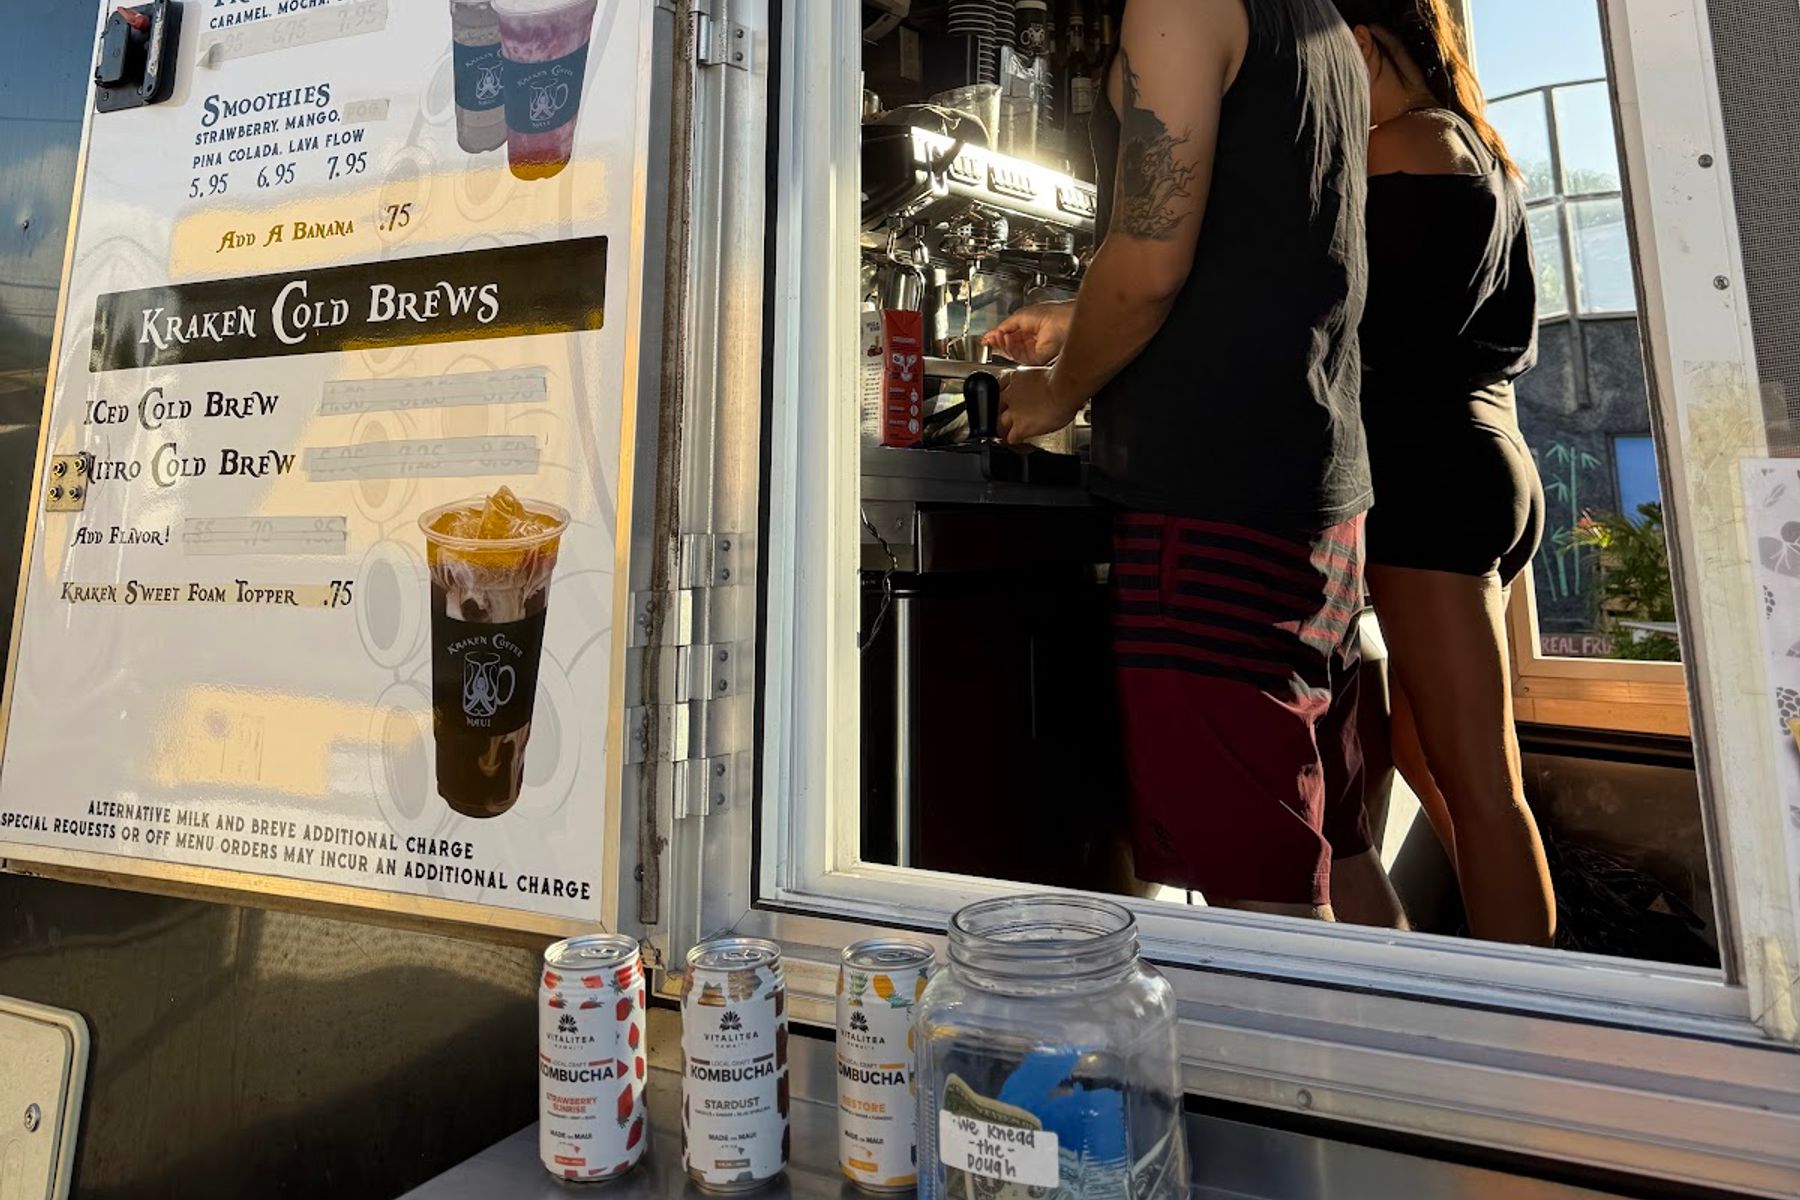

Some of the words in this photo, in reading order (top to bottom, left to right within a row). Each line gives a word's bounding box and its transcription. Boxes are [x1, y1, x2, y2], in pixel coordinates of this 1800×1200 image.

[201, 82, 331, 127] SMOOTHIES
[192, 152, 222, 169] PINA
[289, 136, 319, 153] LAVA
[325, 128, 365, 147] FLOW
[189, 173, 229, 198] 5.95
[256, 162, 296, 188] 6.95
[327, 151, 368, 180] 7.95
[216, 230, 255, 253] ADD
[263, 224, 284, 247] A
[292, 220, 354, 241] BANANA
[379, 202, 412, 233] .75
[139, 305, 257, 350] KRAKEN
[271, 280, 349, 344] COLD
[366, 281, 499, 323] BREWS
[83, 400, 129, 425] ICED
[138, 387, 192, 431] COLD
[204, 391, 279, 419] BREW
[151, 443, 207, 487] COLD
[218, 449, 296, 478] BREW
[71, 526, 103, 547] ADD
[108, 525, 170, 546] FLAVOR!
[61, 582, 117, 604] KRAKEN
[125, 580, 180, 605] SWEET
[188, 583, 226, 602] FOAM
[235, 578, 299, 606] TOPPER
[323, 580, 354, 608] .75
[88, 800, 170, 823] ALTERNATIVE
[177, 809, 209, 828] MILK
[216, 814, 245, 833] AND
[251, 819, 296, 838] BREVE
[302, 823, 398, 851] ADDITIONAL
[406, 836, 474, 860] CHARGE
[1, 813, 48, 831] SPECIAL
[54, 818, 116, 839] REQUESTS
[122, 826, 140, 842] OR
[146, 829, 170, 846] OFF
[176, 833, 214, 851] MENU
[221, 838, 278, 861] ORDERS
[283, 846, 314, 865] MAY
[320, 850, 368, 872] INCUR
[375, 858, 396, 876] AN
[404, 861, 508, 889] ADDITIONAL
[516, 875, 591, 900] CHARGE
[704, 1031, 759, 1042] VITALITEA
[690, 1061, 774, 1083] KOMBUCHA
[704, 1096, 760, 1110] STARDUST
